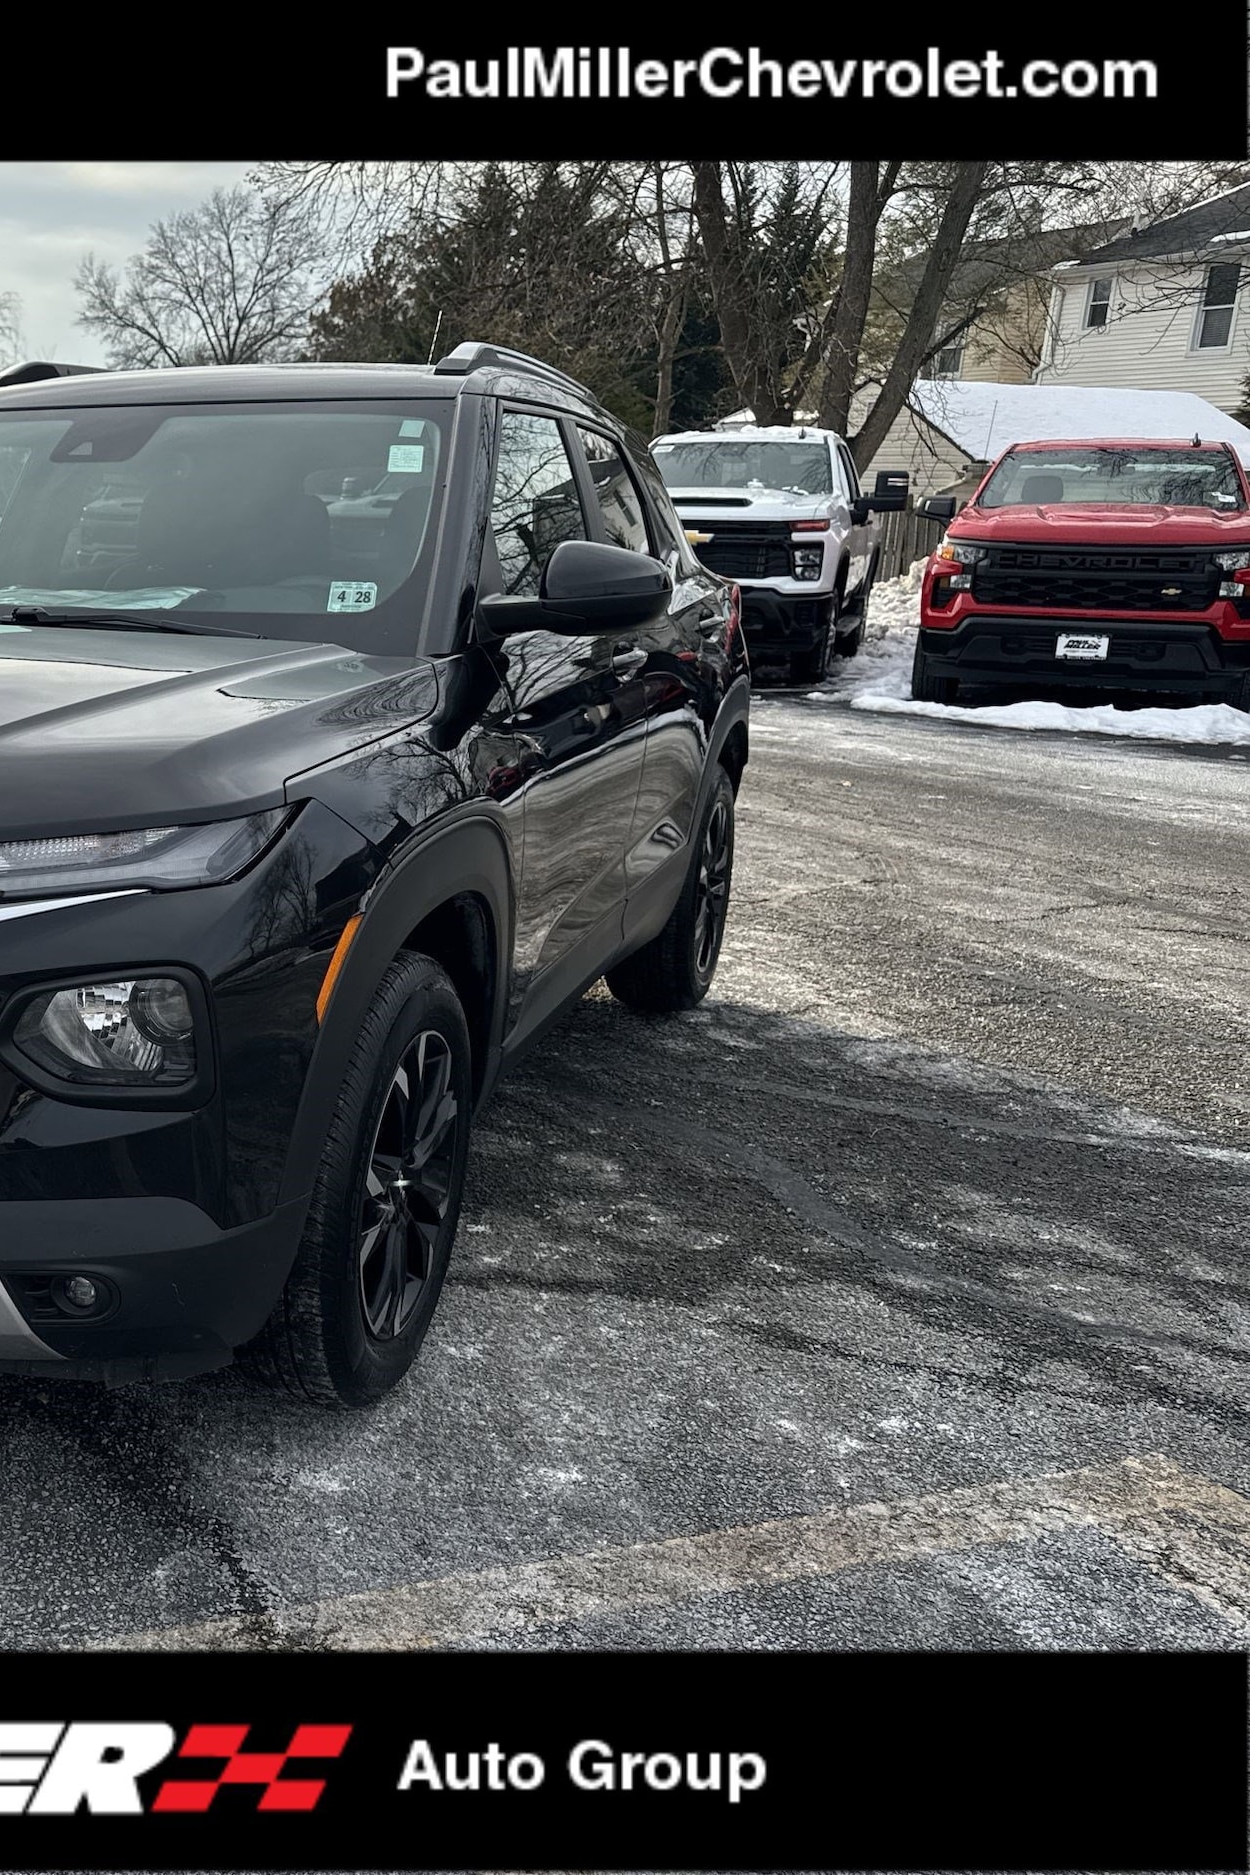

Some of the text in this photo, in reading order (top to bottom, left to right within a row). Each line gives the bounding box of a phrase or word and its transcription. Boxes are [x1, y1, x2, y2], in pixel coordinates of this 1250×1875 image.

[996, 553, 1199, 569] CHEVROLET
[337, 590, 371, 603] 4 28
